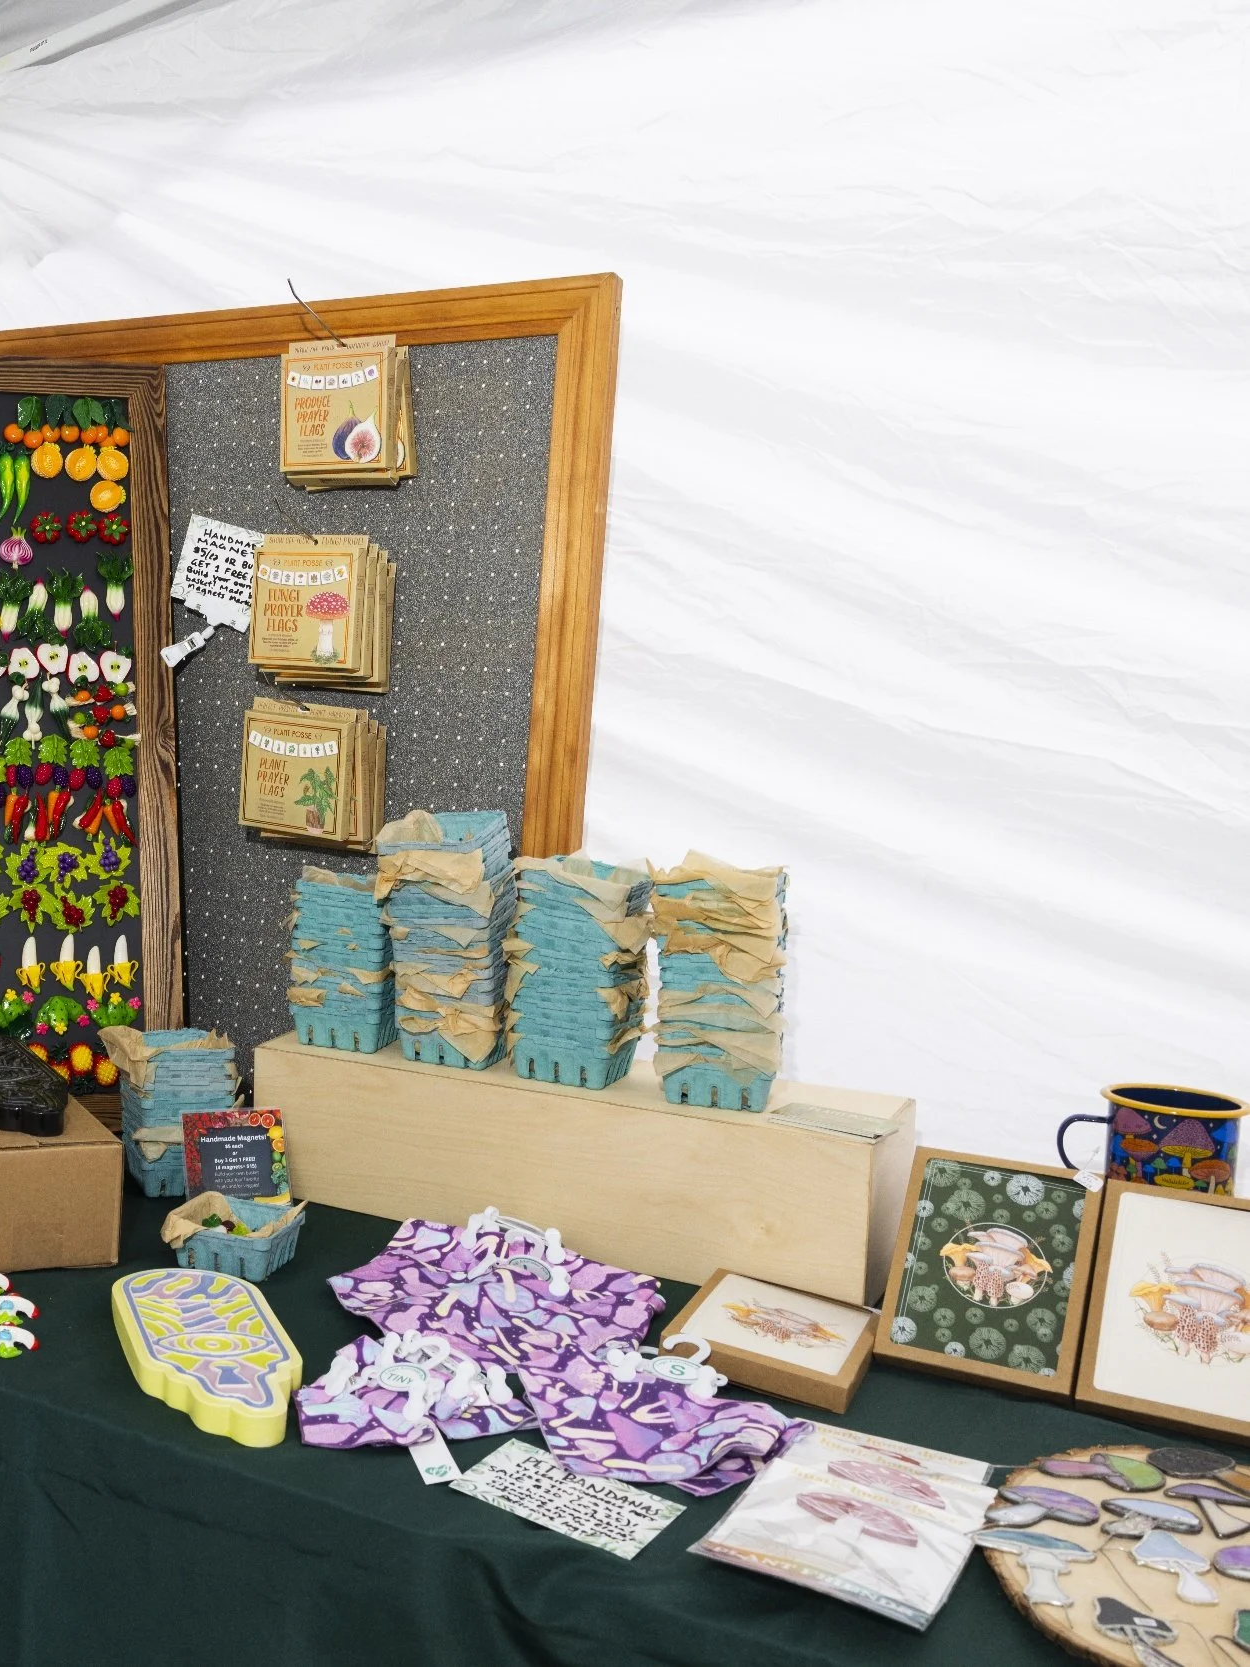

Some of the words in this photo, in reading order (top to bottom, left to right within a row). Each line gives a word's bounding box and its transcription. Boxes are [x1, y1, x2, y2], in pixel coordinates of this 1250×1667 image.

[332, 361, 353, 370] POSSE
[295, 395, 331, 411] PRODUCE
[297, 409, 330, 424] PRAYER
[300, 424, 325, 437] FLAGS
[203, 528, 256, 550] HANDMAD
[197, 537, 255, 559] MAGNET
[190, 558, 210, 568] GET
[214, 564, 219, 572] 1
[224, 567, 248, 580] FREE
[241, 560, 253, 569] BU
[185, 570, 216, 589] basket!
[186, 565, 208, 578] Build
[212, 574, 231, 586] your
[233, 580, 251, 589] own
[268, 588, 300, 602] FUNGI
[264, 603, 304, 617] PRAYER
[266, 618, 298, 632] FLAGS
[292, 730, 312, 739] POSSE
[260, 757, 288, 771] PLANT
[257, 770, 290, 785] PRAYER
[259, 782, 285, 798] FLAGS
[237, 1134, 267, 1142] Magnets!
[670, 1365, 685, 1376] S
[490, 1465, 523, 1481] SALE
[522, 1456, 560, 1473] PET
[562, 1471, 661, 1516] BANDANAS
